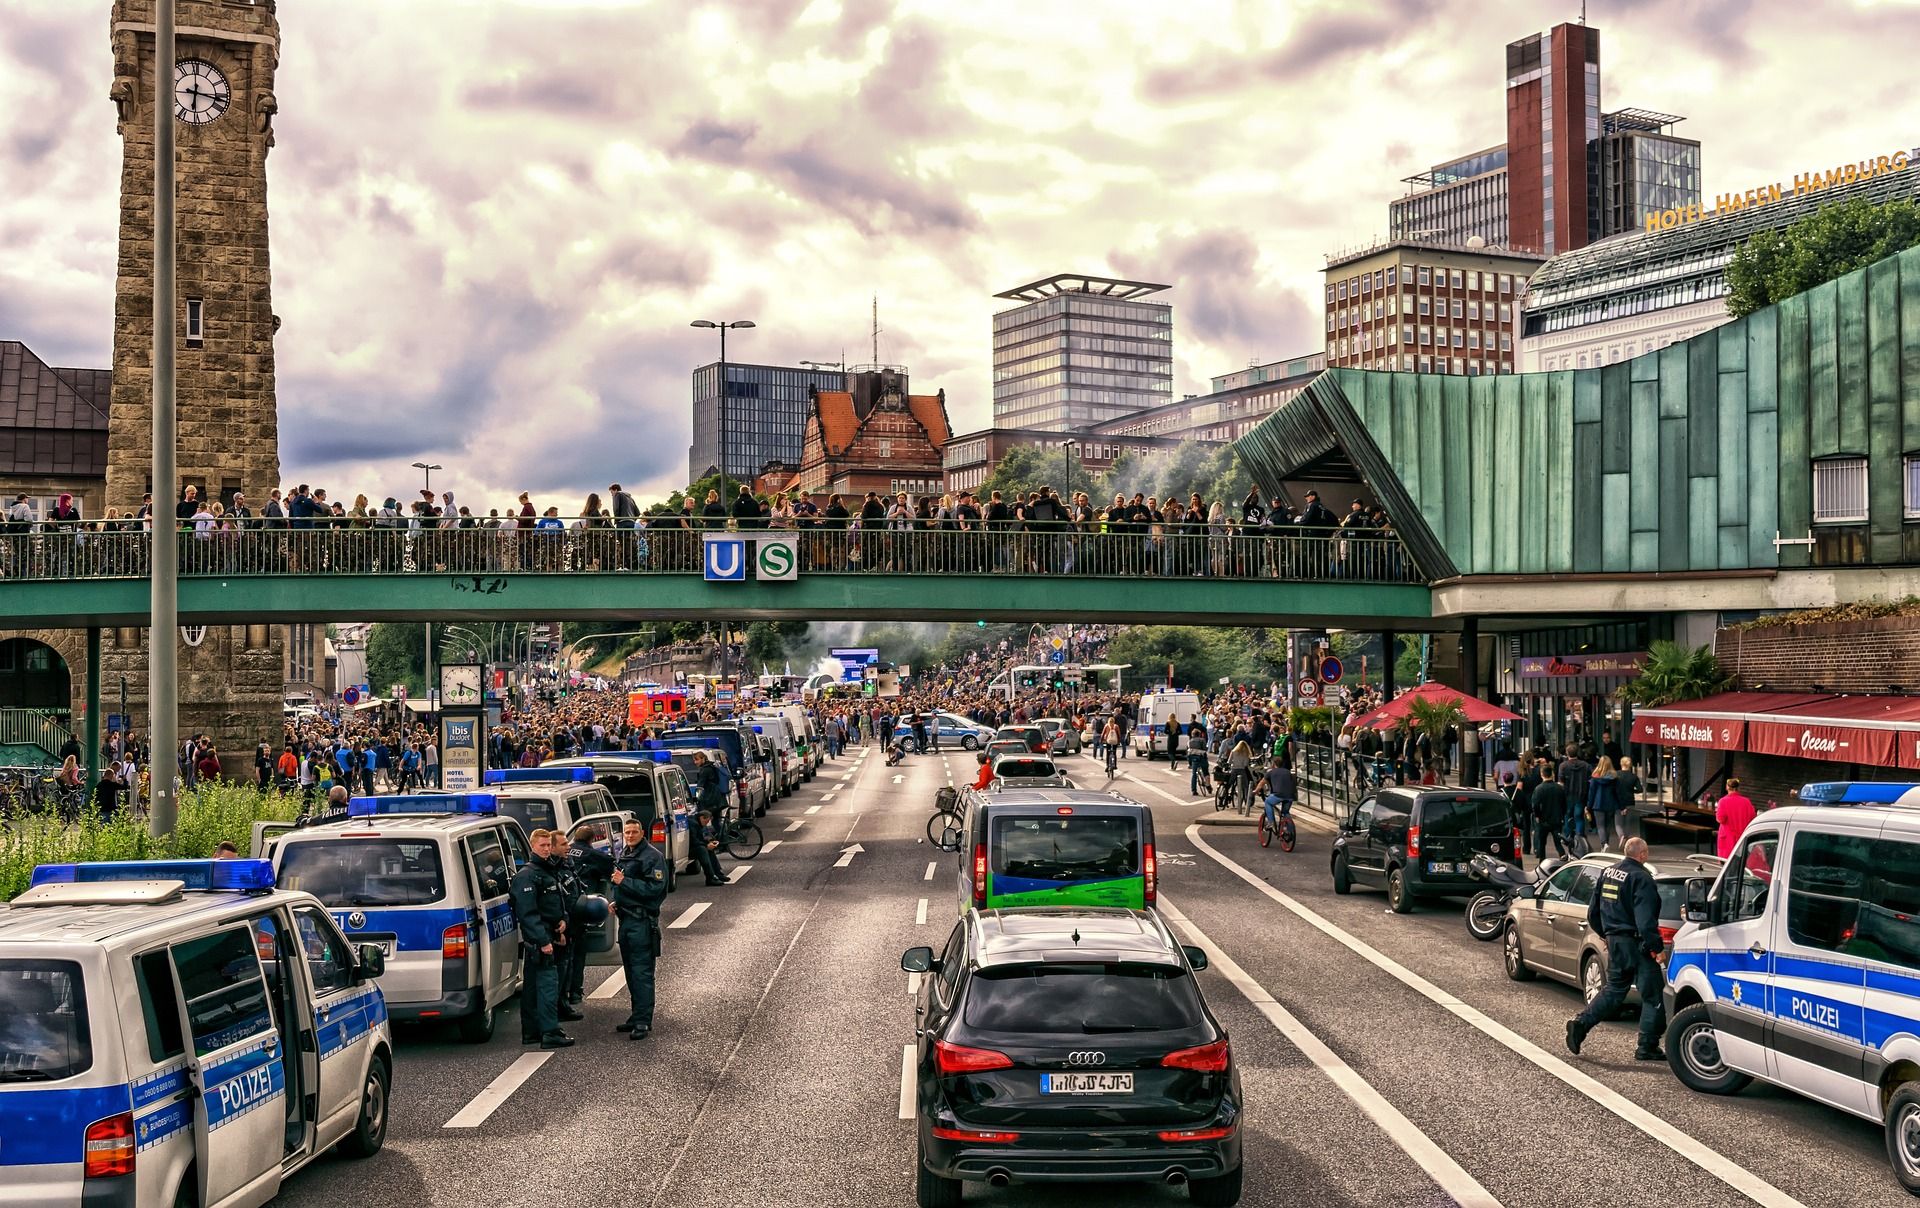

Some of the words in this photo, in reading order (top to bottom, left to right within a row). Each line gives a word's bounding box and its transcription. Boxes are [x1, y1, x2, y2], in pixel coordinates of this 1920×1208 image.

[1645, 202, 1709, 234] HOTEL
[1715, 182, 1782, 216] HAFEN
[1793, 150, 1908, 197] HAMBURG
[710, 543, 739, 577] U
[765, 545, 789, 575] S
[449, 733, 471, 741] budget
[452, 726, 468, 735] ibis
[1660, 723, 1680, 740] Fisch
[1681, 723, 1687, 741] &
[1688, 724, 1713, 742] Steak
[1801, 730, 1837, 752] Ocean
[1602, 867, 1629, 882] POLIZEI
[492, 914, 514, 939] POLIZEI
[1792, 996, 1840, 1030] POLIZEI
[218, 1064, 273, 1116] POLIZEI
